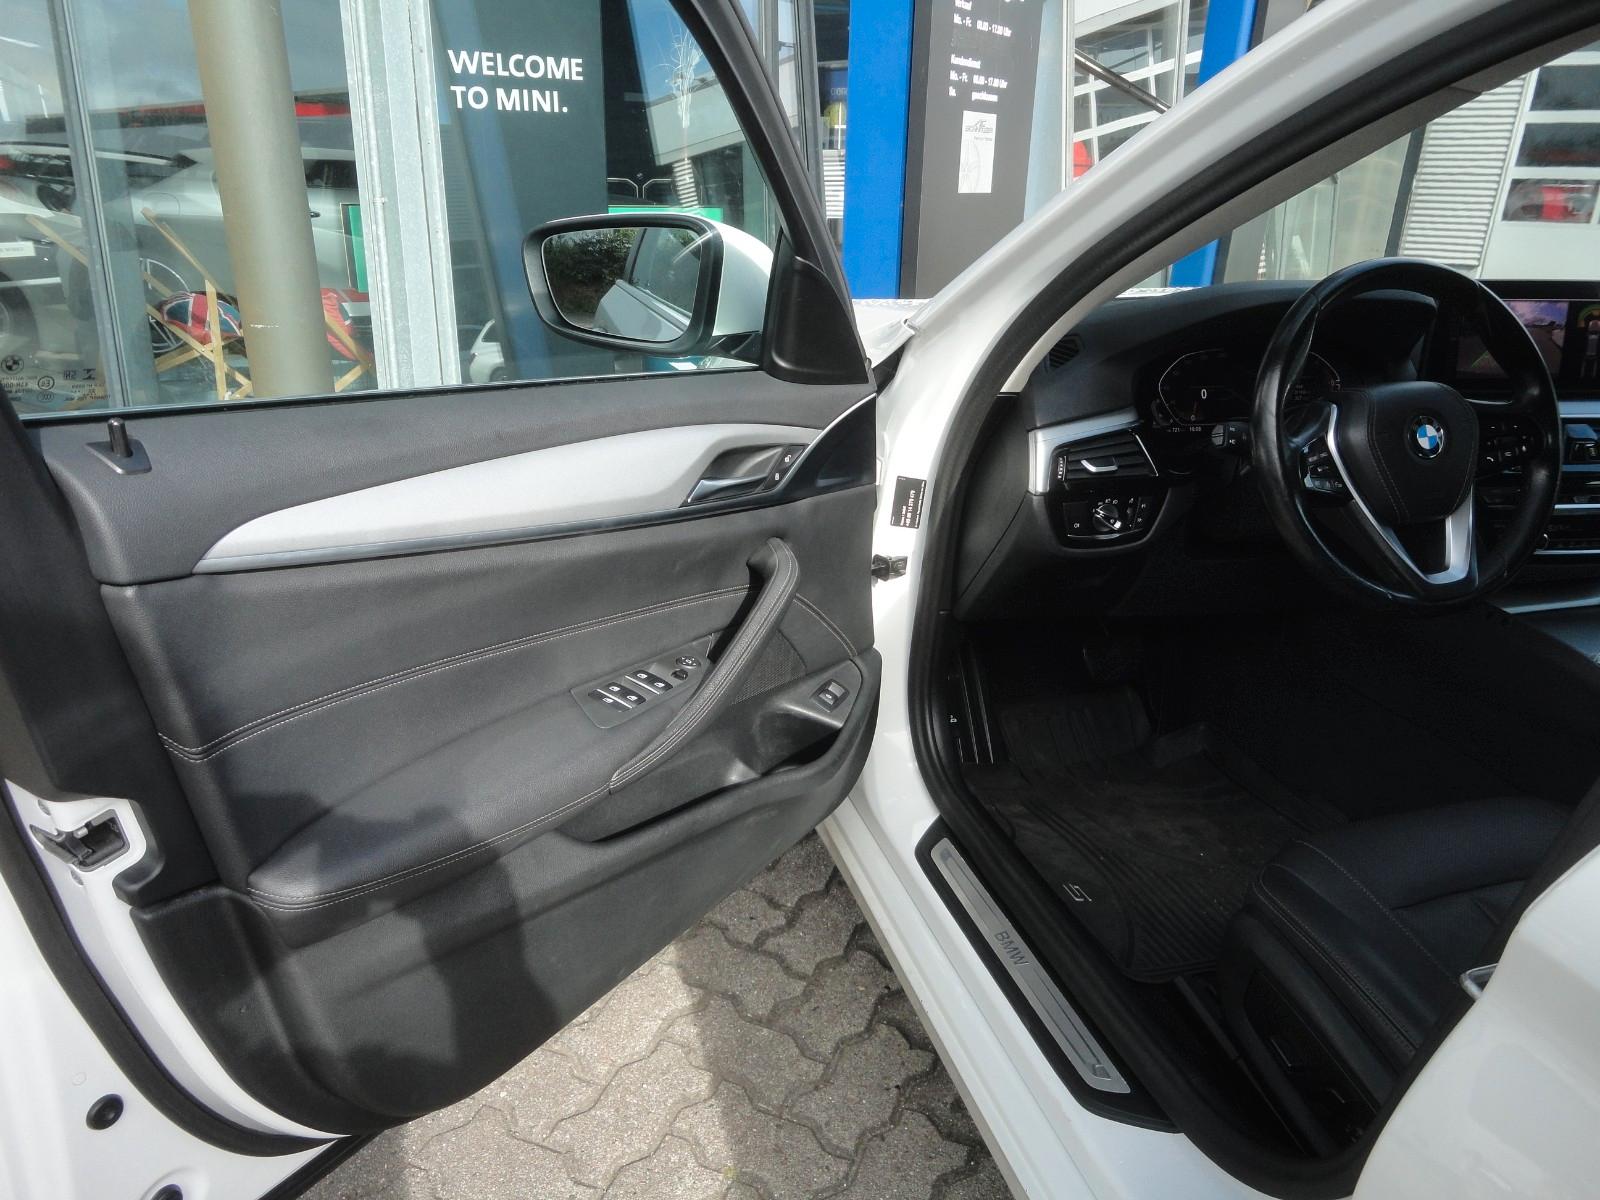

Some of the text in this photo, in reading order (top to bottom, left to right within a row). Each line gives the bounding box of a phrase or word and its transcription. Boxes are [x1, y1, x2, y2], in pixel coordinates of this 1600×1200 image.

[447, 49, 584, 81] WELCOME
[450, 85, 568, 113] TO MINI.
[1201, 388, 1208, 400] 0
[994, 930, 1030, 966] BMW
